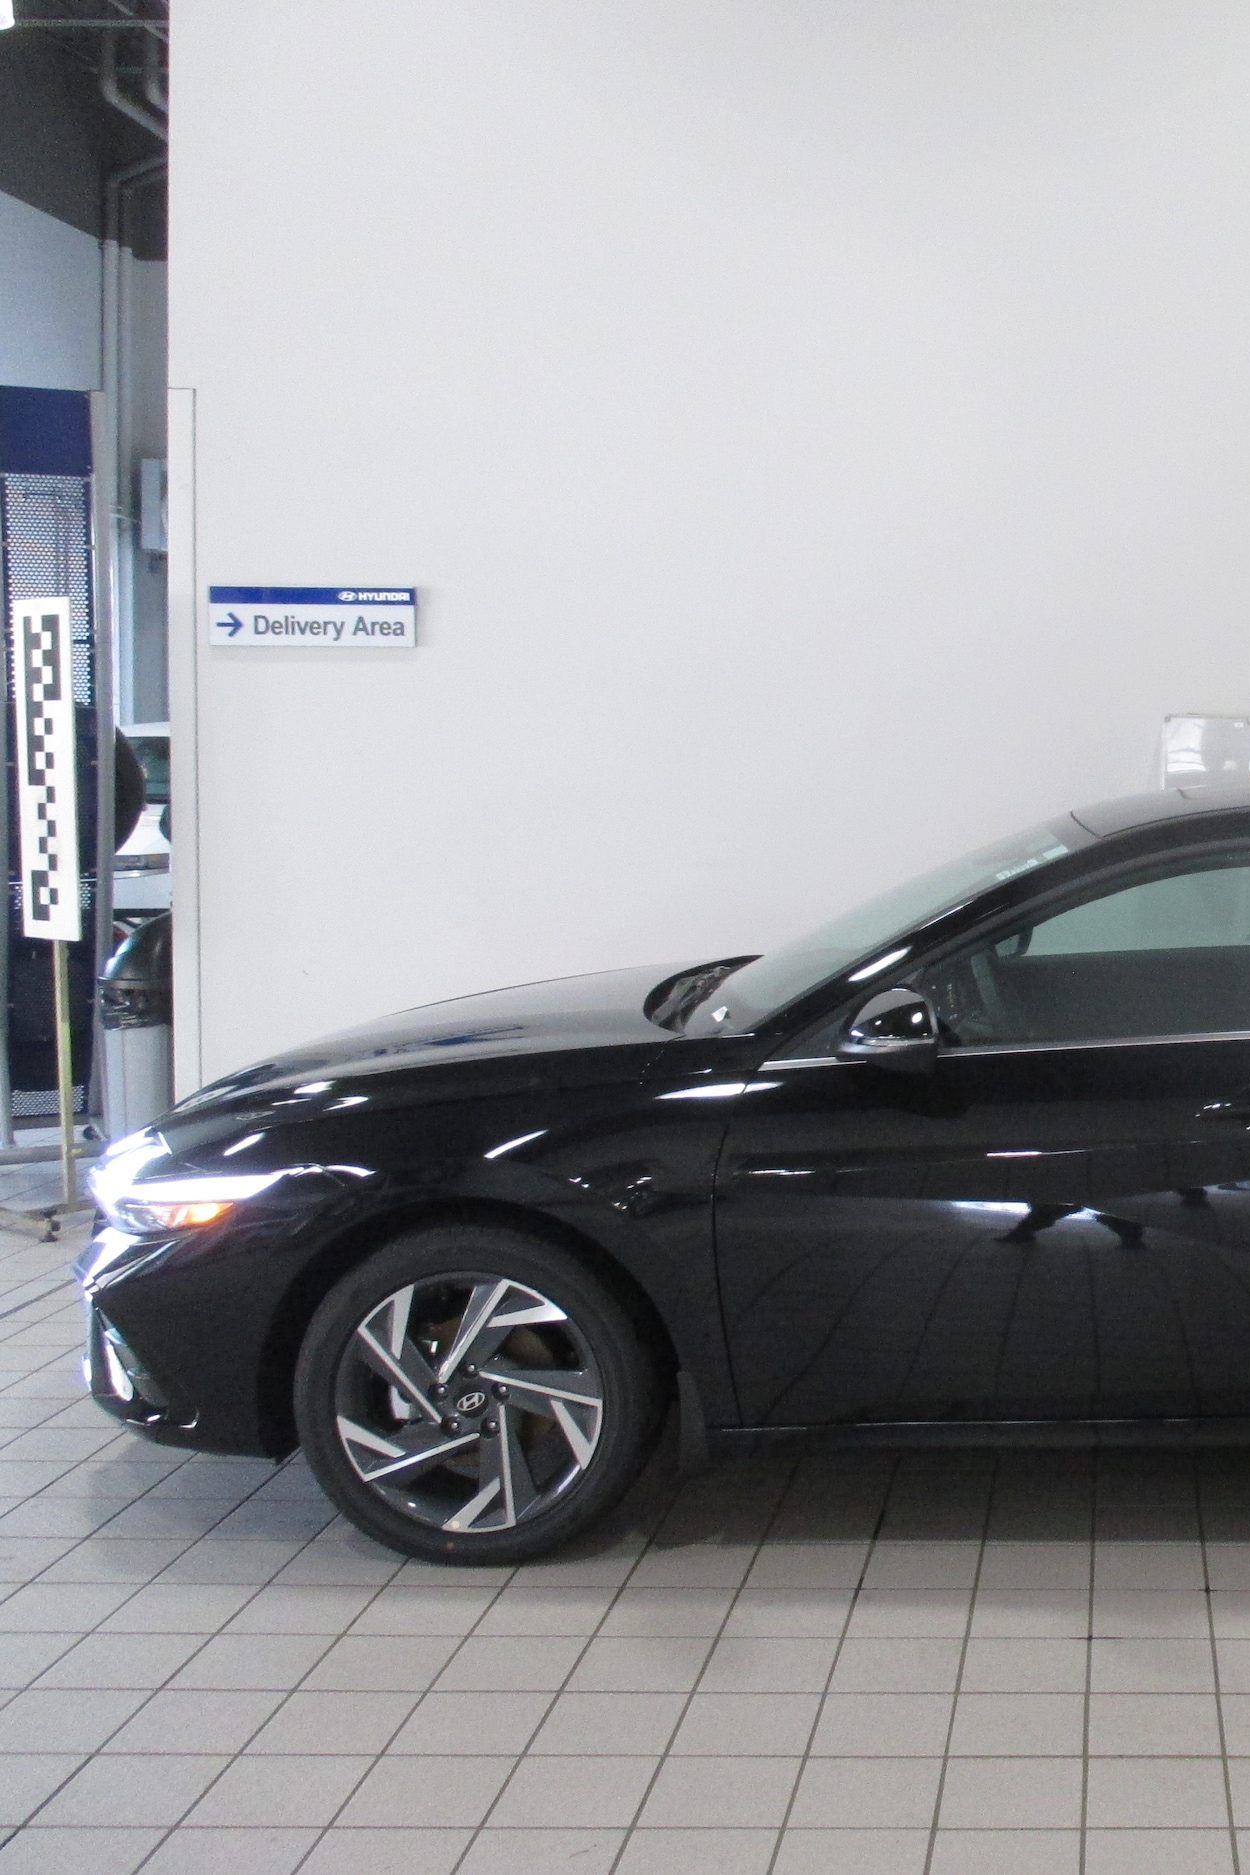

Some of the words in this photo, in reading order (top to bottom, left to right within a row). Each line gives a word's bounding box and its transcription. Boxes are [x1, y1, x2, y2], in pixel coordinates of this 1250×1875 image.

[358, 591, 410, 602] HYUNDAI
[253, 615, 346, 641] Delivery
[352, 616, 405, 637] Area
